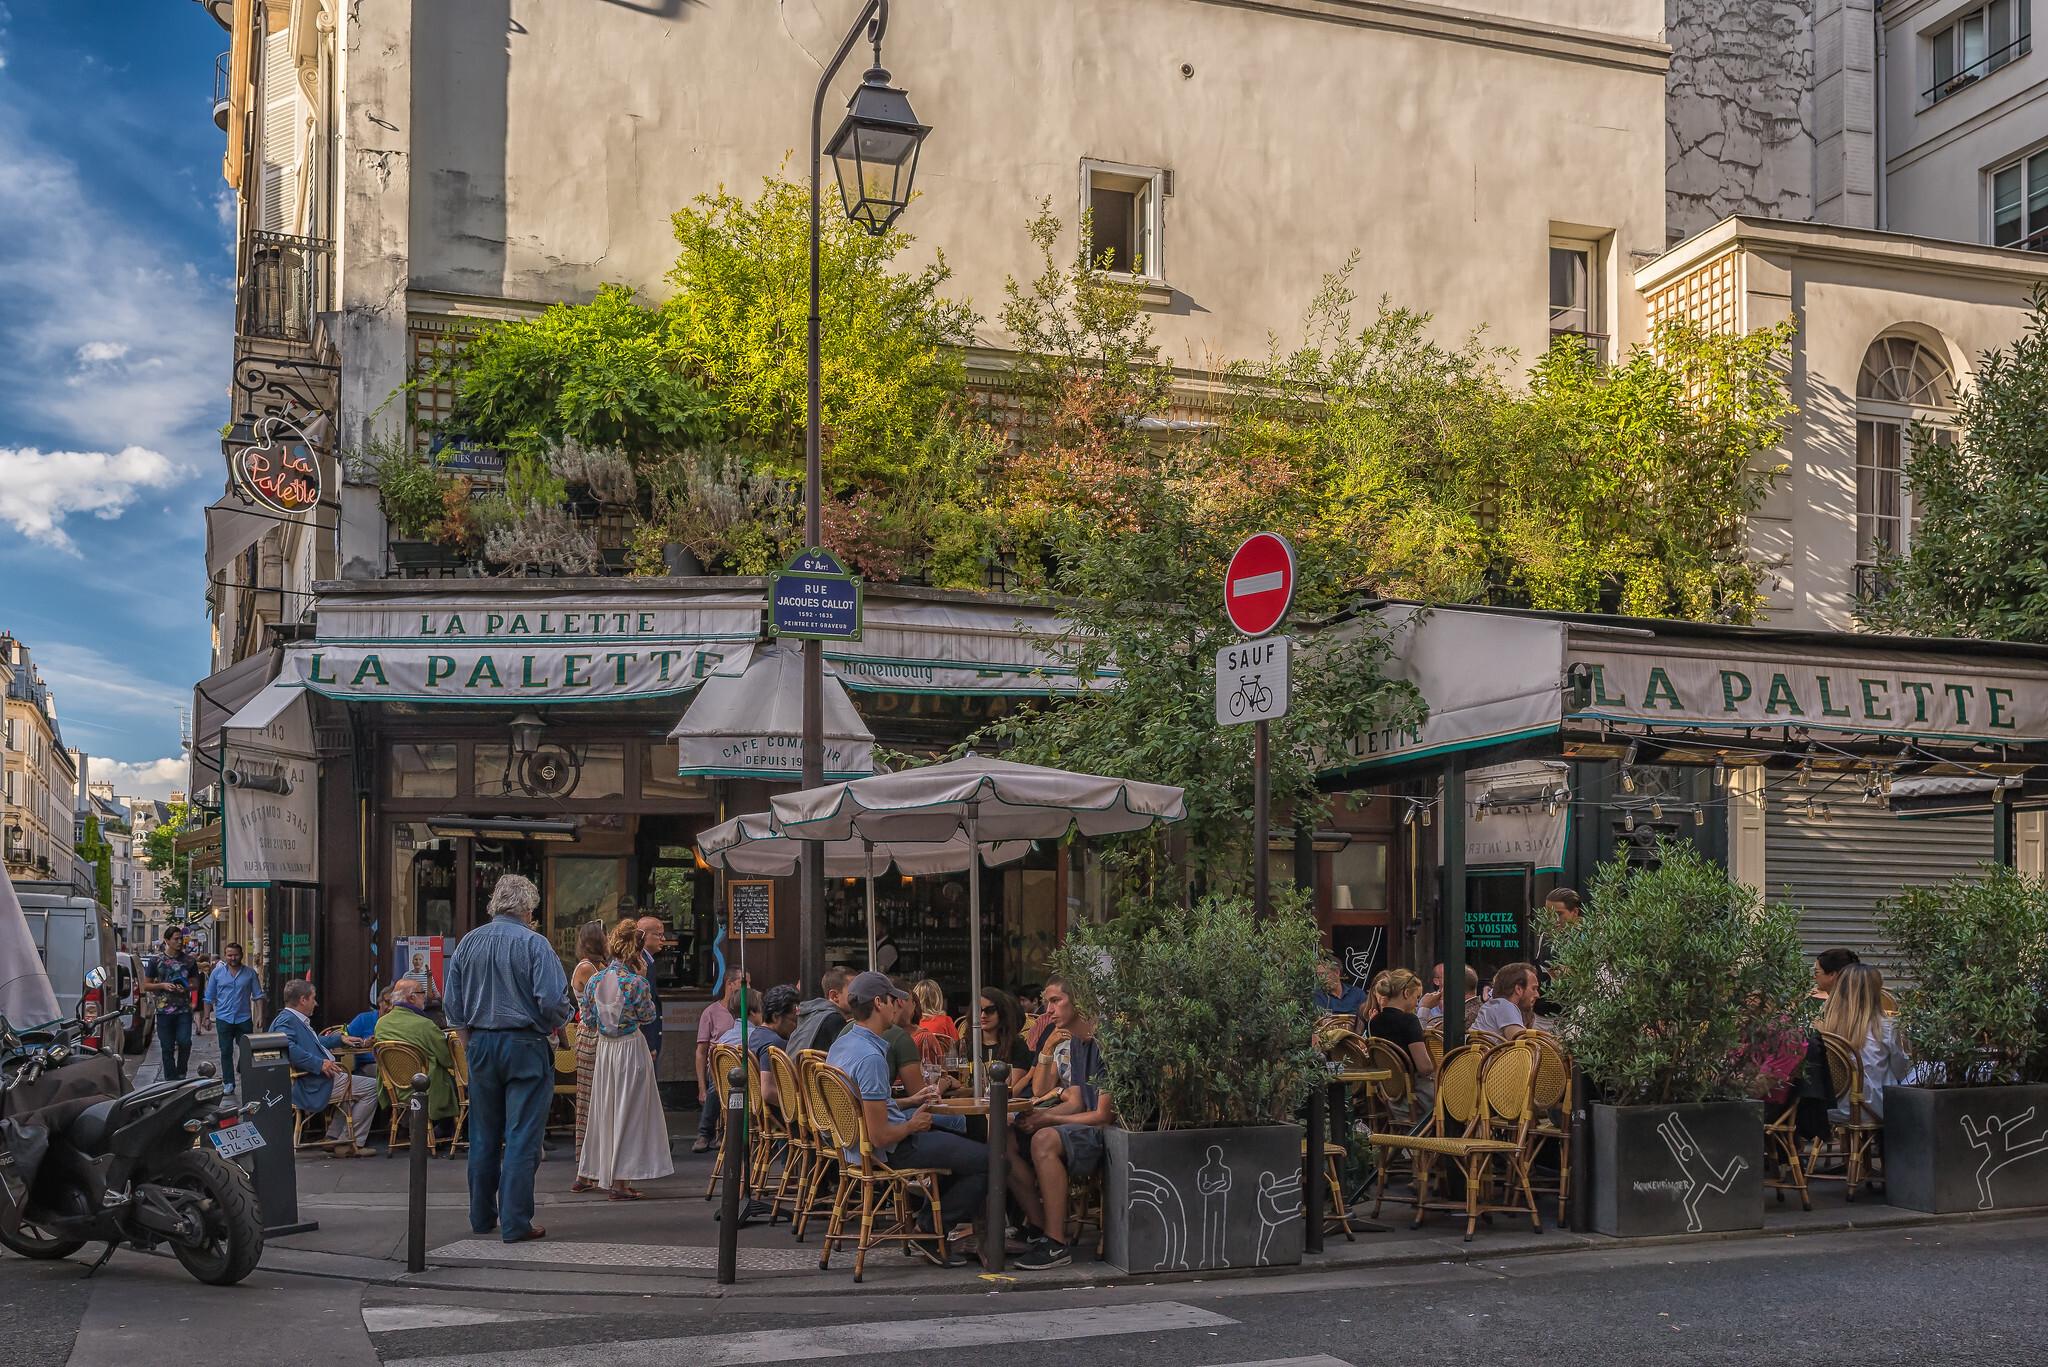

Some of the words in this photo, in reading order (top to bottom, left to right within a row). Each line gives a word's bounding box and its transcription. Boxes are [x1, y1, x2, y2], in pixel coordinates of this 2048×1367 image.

[283, 446, 313, 472] La
[252, 454, 317, 503] Palette
[804, 585, 828, 594] RUE
[777, 596, 819, 608] JACQUES
[821, 600, 854, 610] CALLOT
[421, 614, 467, 635] LA
[486, 613, 656, 634] PALETTE
[784, 620, 809, 628] PEINTRE
[1228, 643, 1275, 671] SAUF
[308, 653, 389, 686] LA
[424, 650, 725, 689] PALETTE
[1590, 663, 1685, 711] LA
[1719, 669, 2017, 729] PALETTE
[722, 738, 758, 758] CAFE
[745, 755, 787, 767] DEPUIS
[791, 758, 803, 767] 19
[1465, 924, 1476, 934] OS
[1479, 924, 1518, 934] VOISINS
[1481, 940, 1501, 948] POUR
[1504, 940, 1520, 948] EUX
